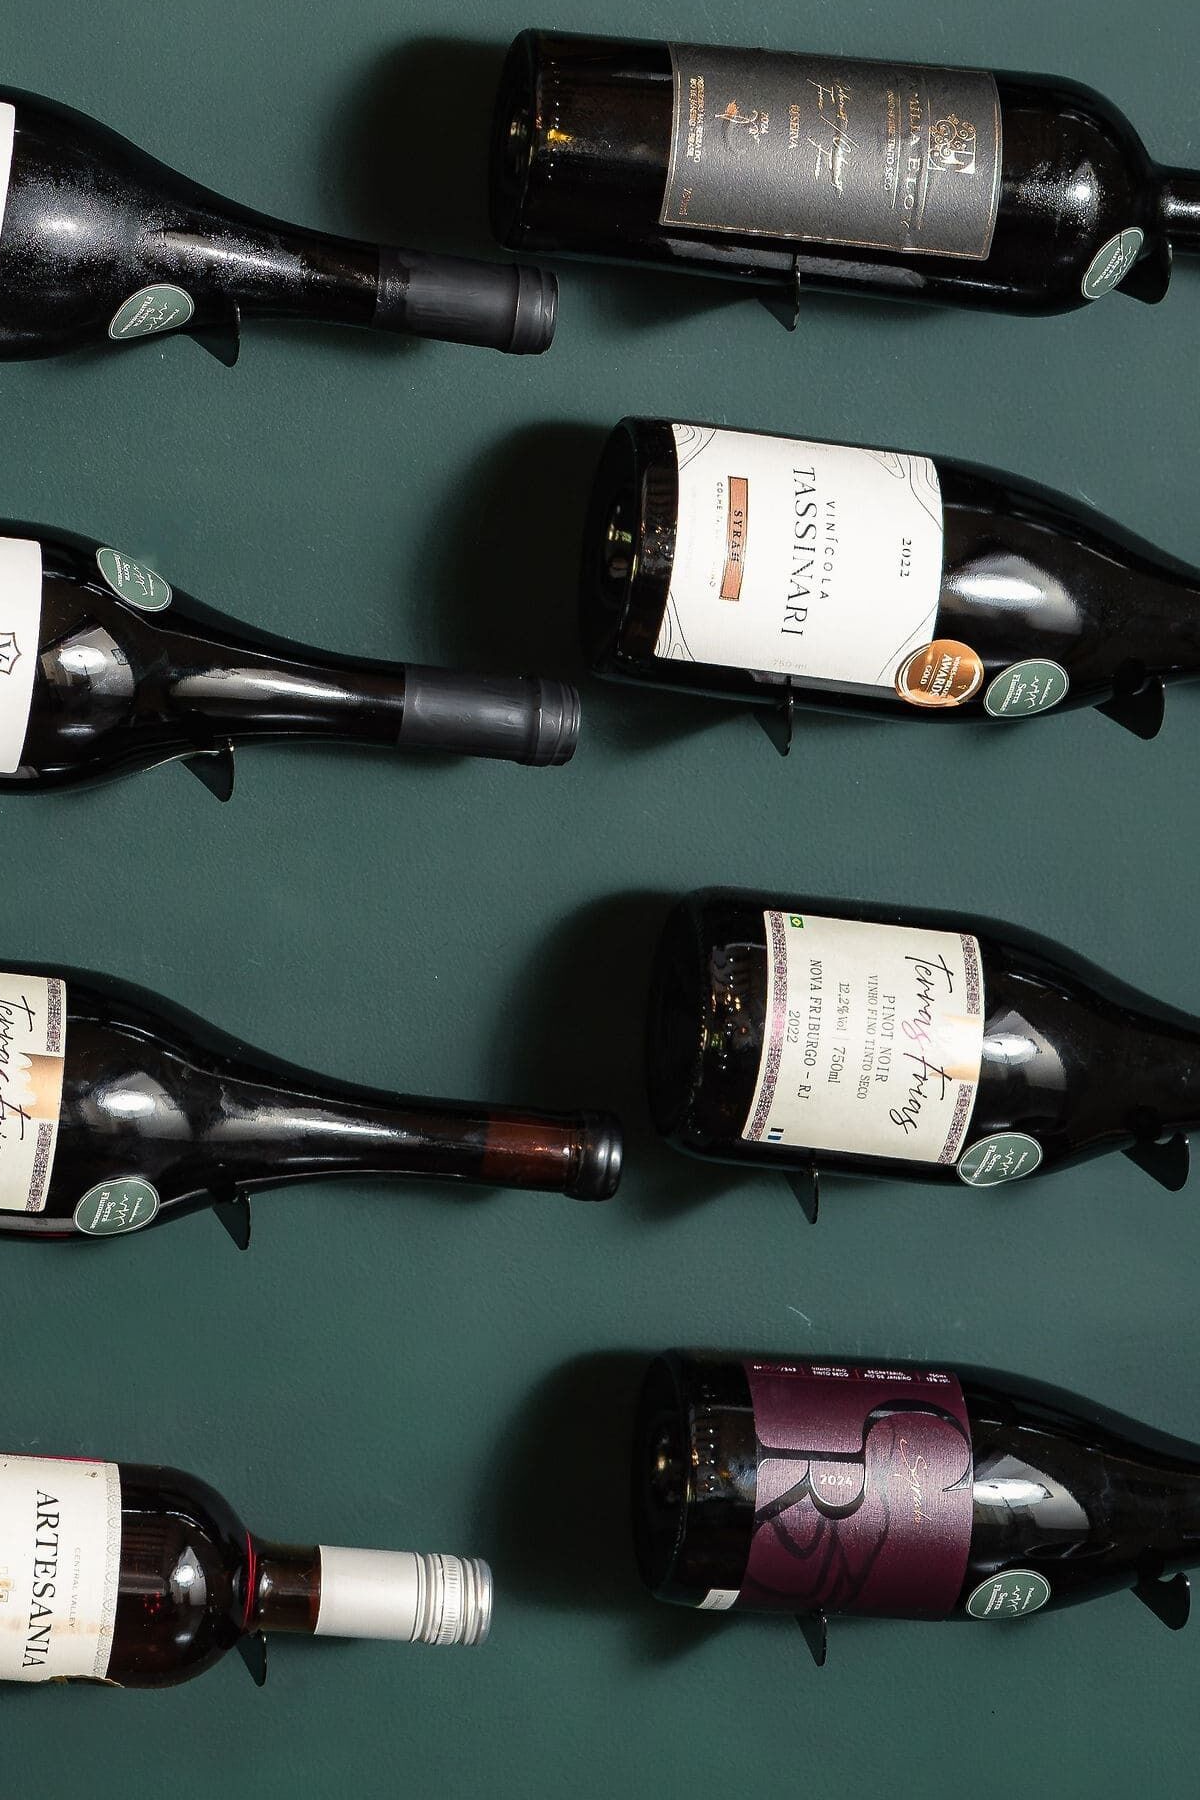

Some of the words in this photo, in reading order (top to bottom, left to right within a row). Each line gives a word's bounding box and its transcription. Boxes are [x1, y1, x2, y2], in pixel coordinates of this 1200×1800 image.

[884, 167, 894, 191] SECO
[780, 467, 818, 637] TASSINARI
[819, 501, 837, 600] VINÍCOLA
[899, 538, 912, 578] 2022
[809, 959, 822, 991] NOVA
[880, 995, 896, 1041] PINOT
[901, 954, 954, 1044] Terras
[787, 1010, 800, 1043] 2022
[804, 997, 821, 1066] FRIBURGO
[875, 1046, 891, 1082] NOIR
[797, 1084, 810, 1100] RJ
[22, 1490, 59, 1668] ARTESANIA
